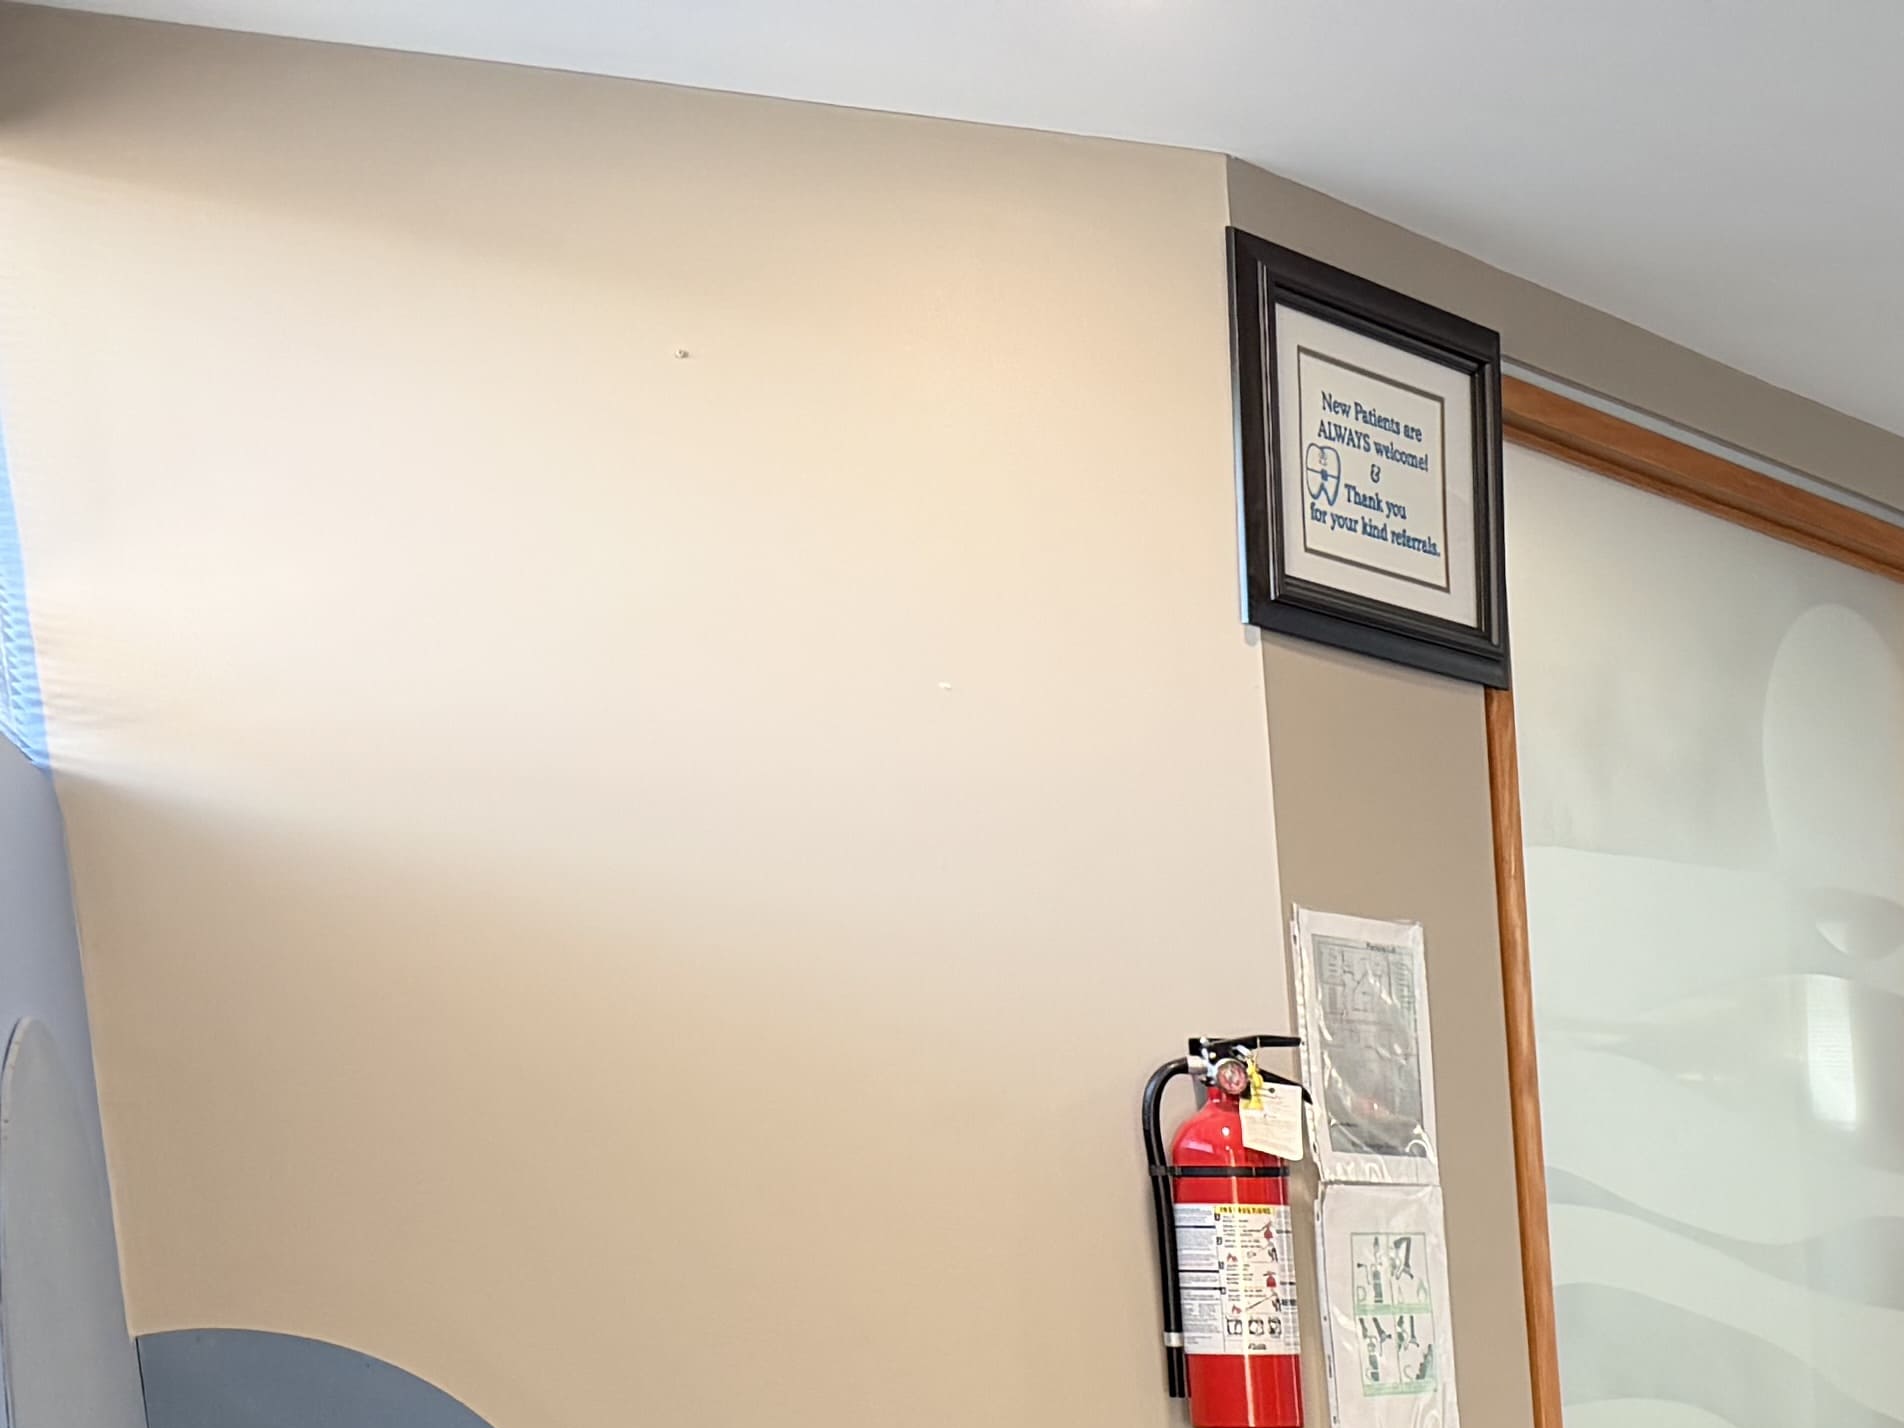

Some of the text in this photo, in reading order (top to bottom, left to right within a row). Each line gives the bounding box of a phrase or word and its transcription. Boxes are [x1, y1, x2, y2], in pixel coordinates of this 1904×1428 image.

[1321, 391, 1422, 442] New Patients are
[1318, 420, 1429, 472] ALWAYS welcome!
[1370, 464, 1381, 483] &
[1344, 484, 1407, 519] Thank you
[1310, 502, 1441, 557] for your kind referrals.
